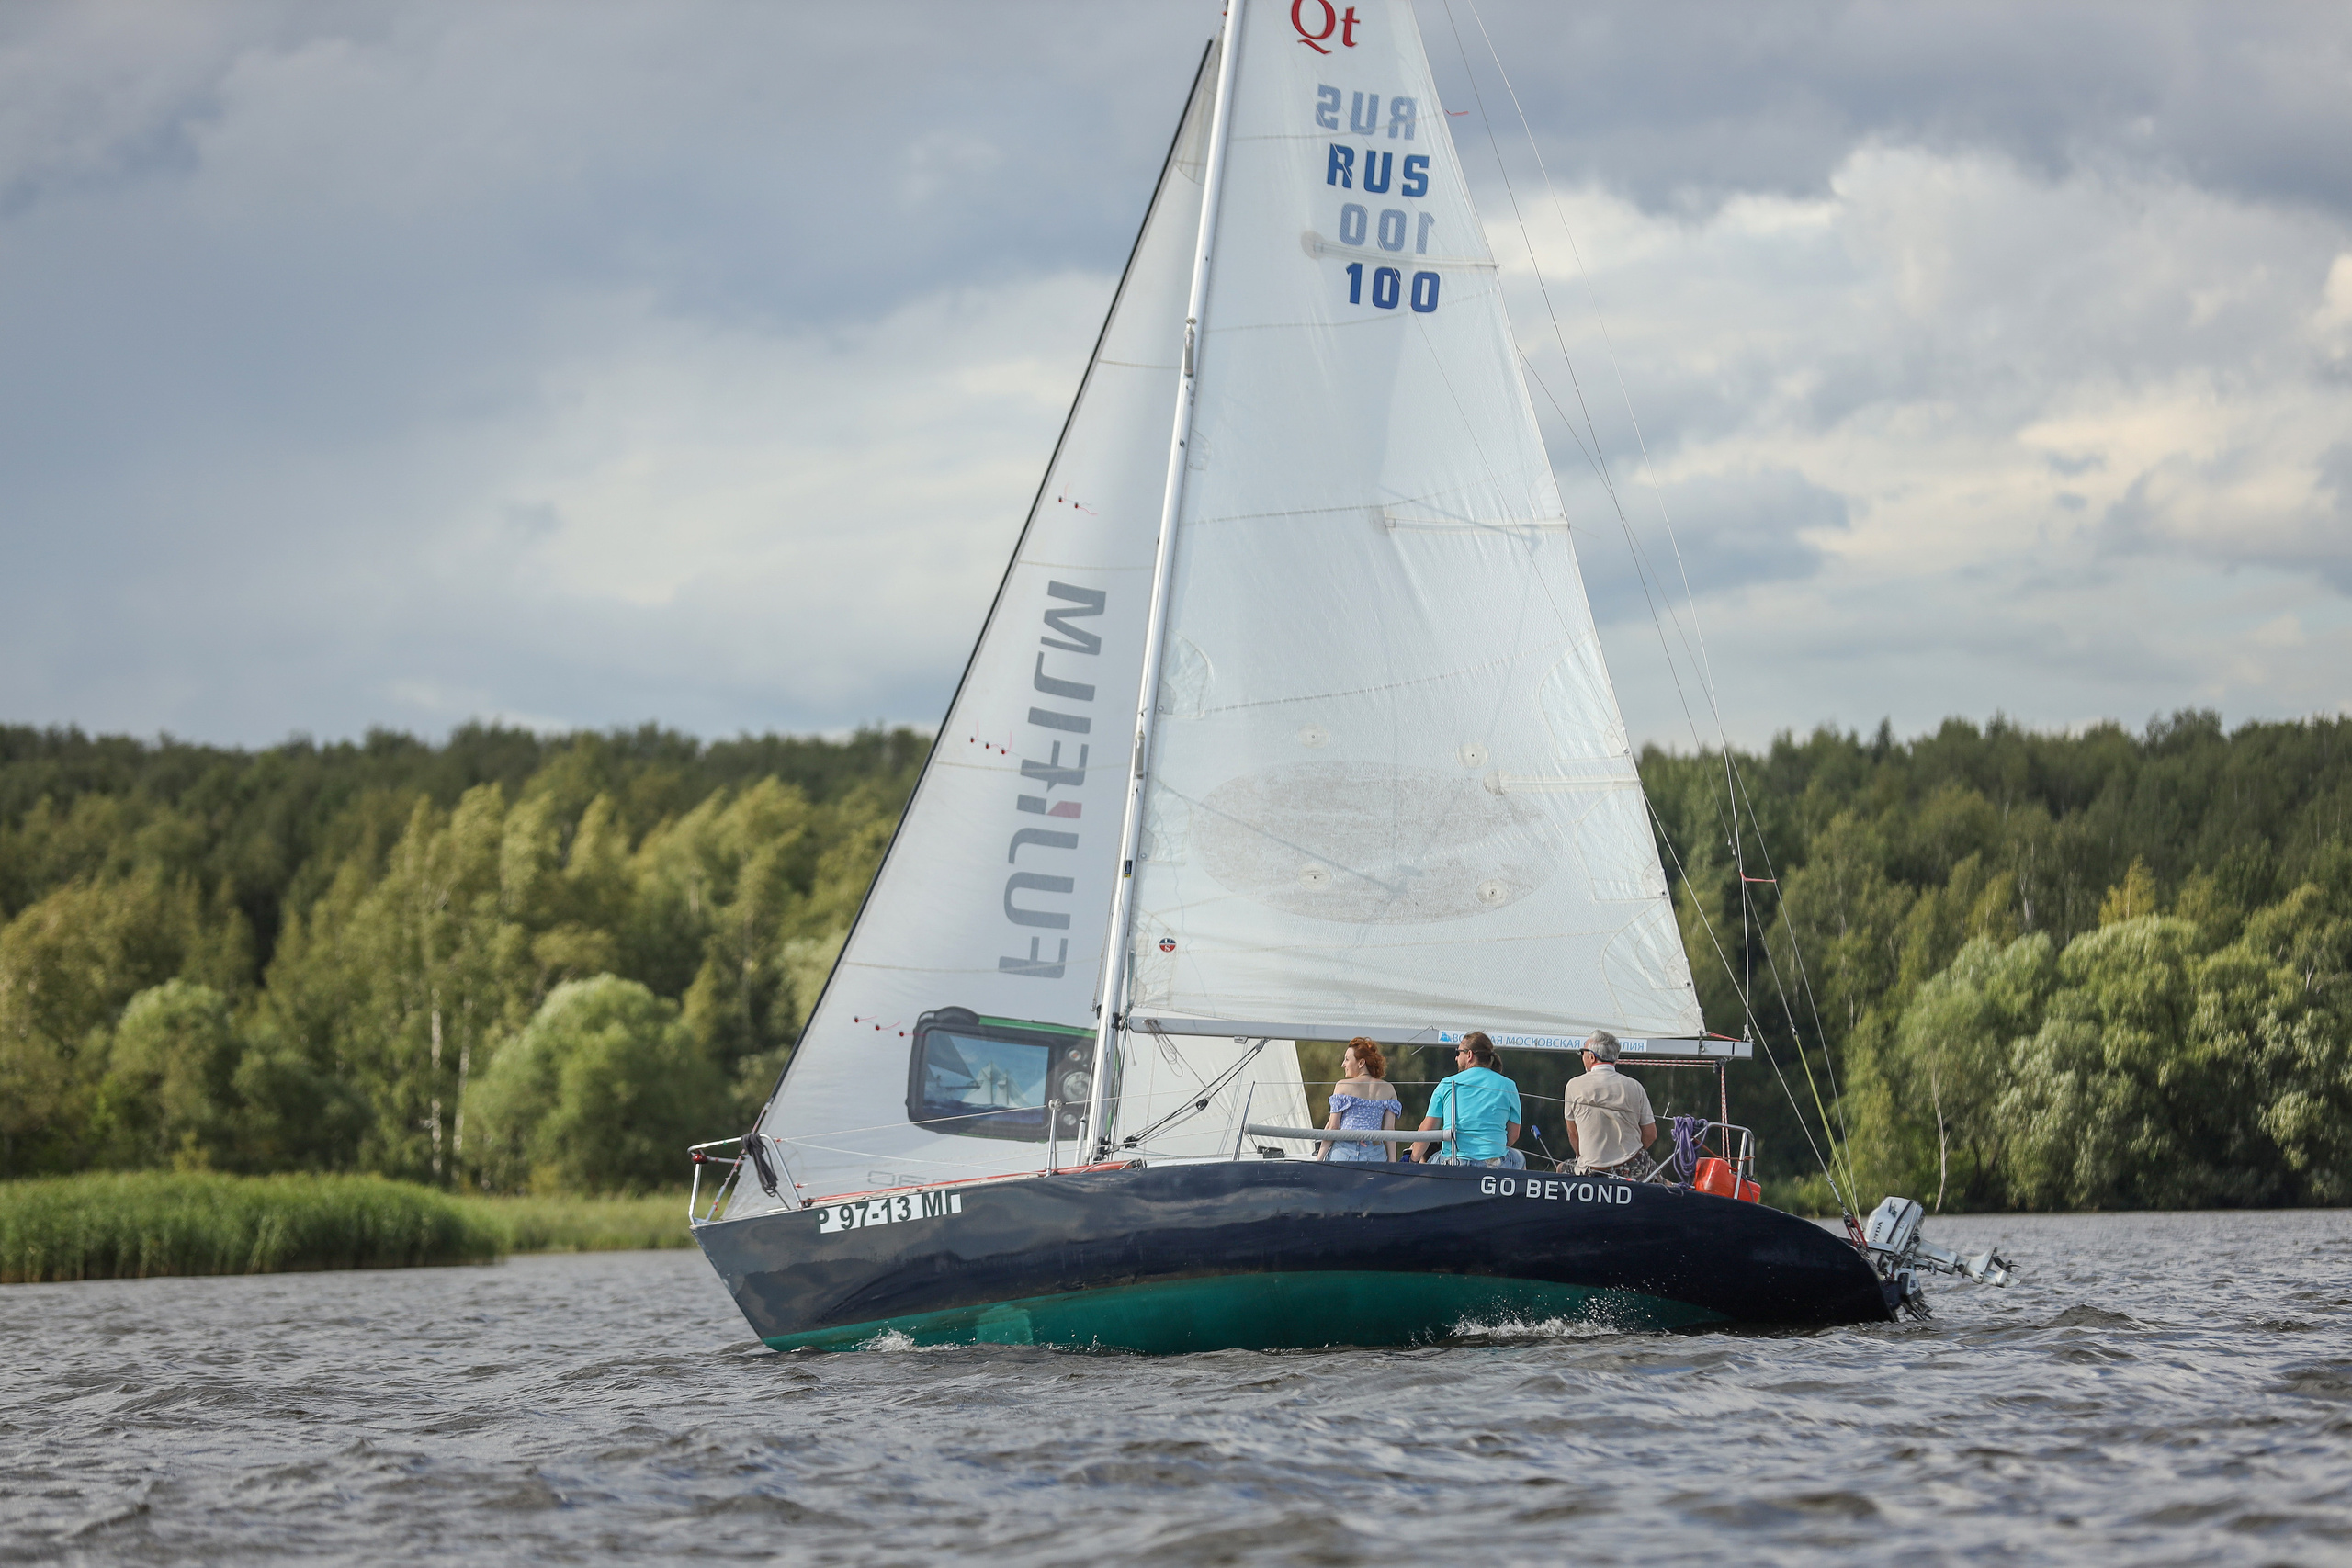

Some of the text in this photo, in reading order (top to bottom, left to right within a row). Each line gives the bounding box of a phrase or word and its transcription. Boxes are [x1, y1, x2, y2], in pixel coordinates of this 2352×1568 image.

[1291, 0, 1361, 55] Qt
[1327, 142, 1430, 197] RUS
[1346, 262, 1441, 313] 100
[1506, 1036, 1580, 1049] МОСКОВСКАЯ
[1480, 1176, 1632, 1205] GO BEYOND
[839, 1196, 912, 1229] 97-13
